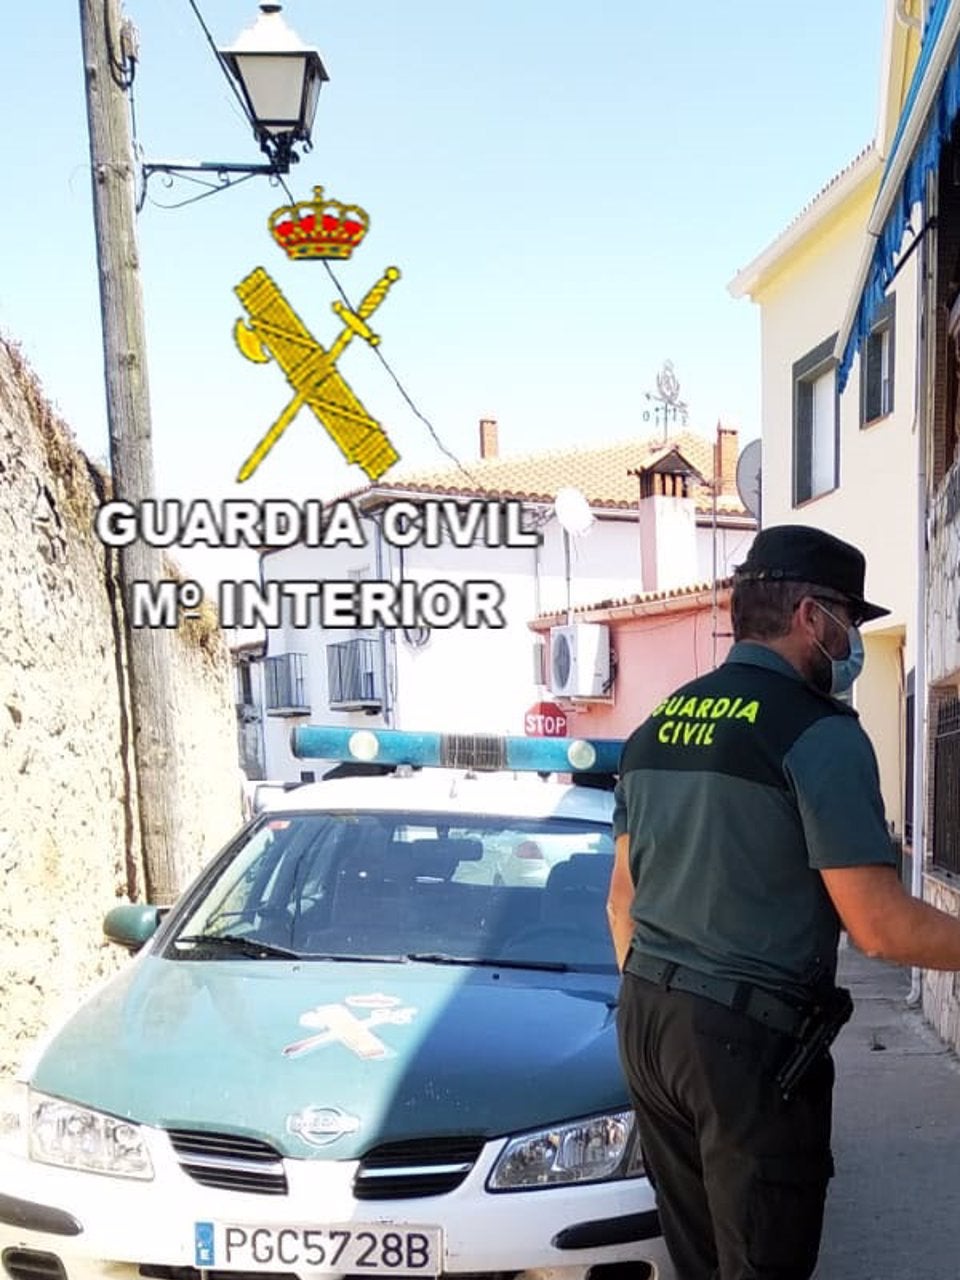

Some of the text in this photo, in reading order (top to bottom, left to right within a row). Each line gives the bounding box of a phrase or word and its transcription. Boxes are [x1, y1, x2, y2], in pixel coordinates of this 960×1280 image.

[526, 714, 566, 734] STOP
[658, 721, 716, 745] CIVIL
[225, 1227, 430, 1269] PGC5728B
